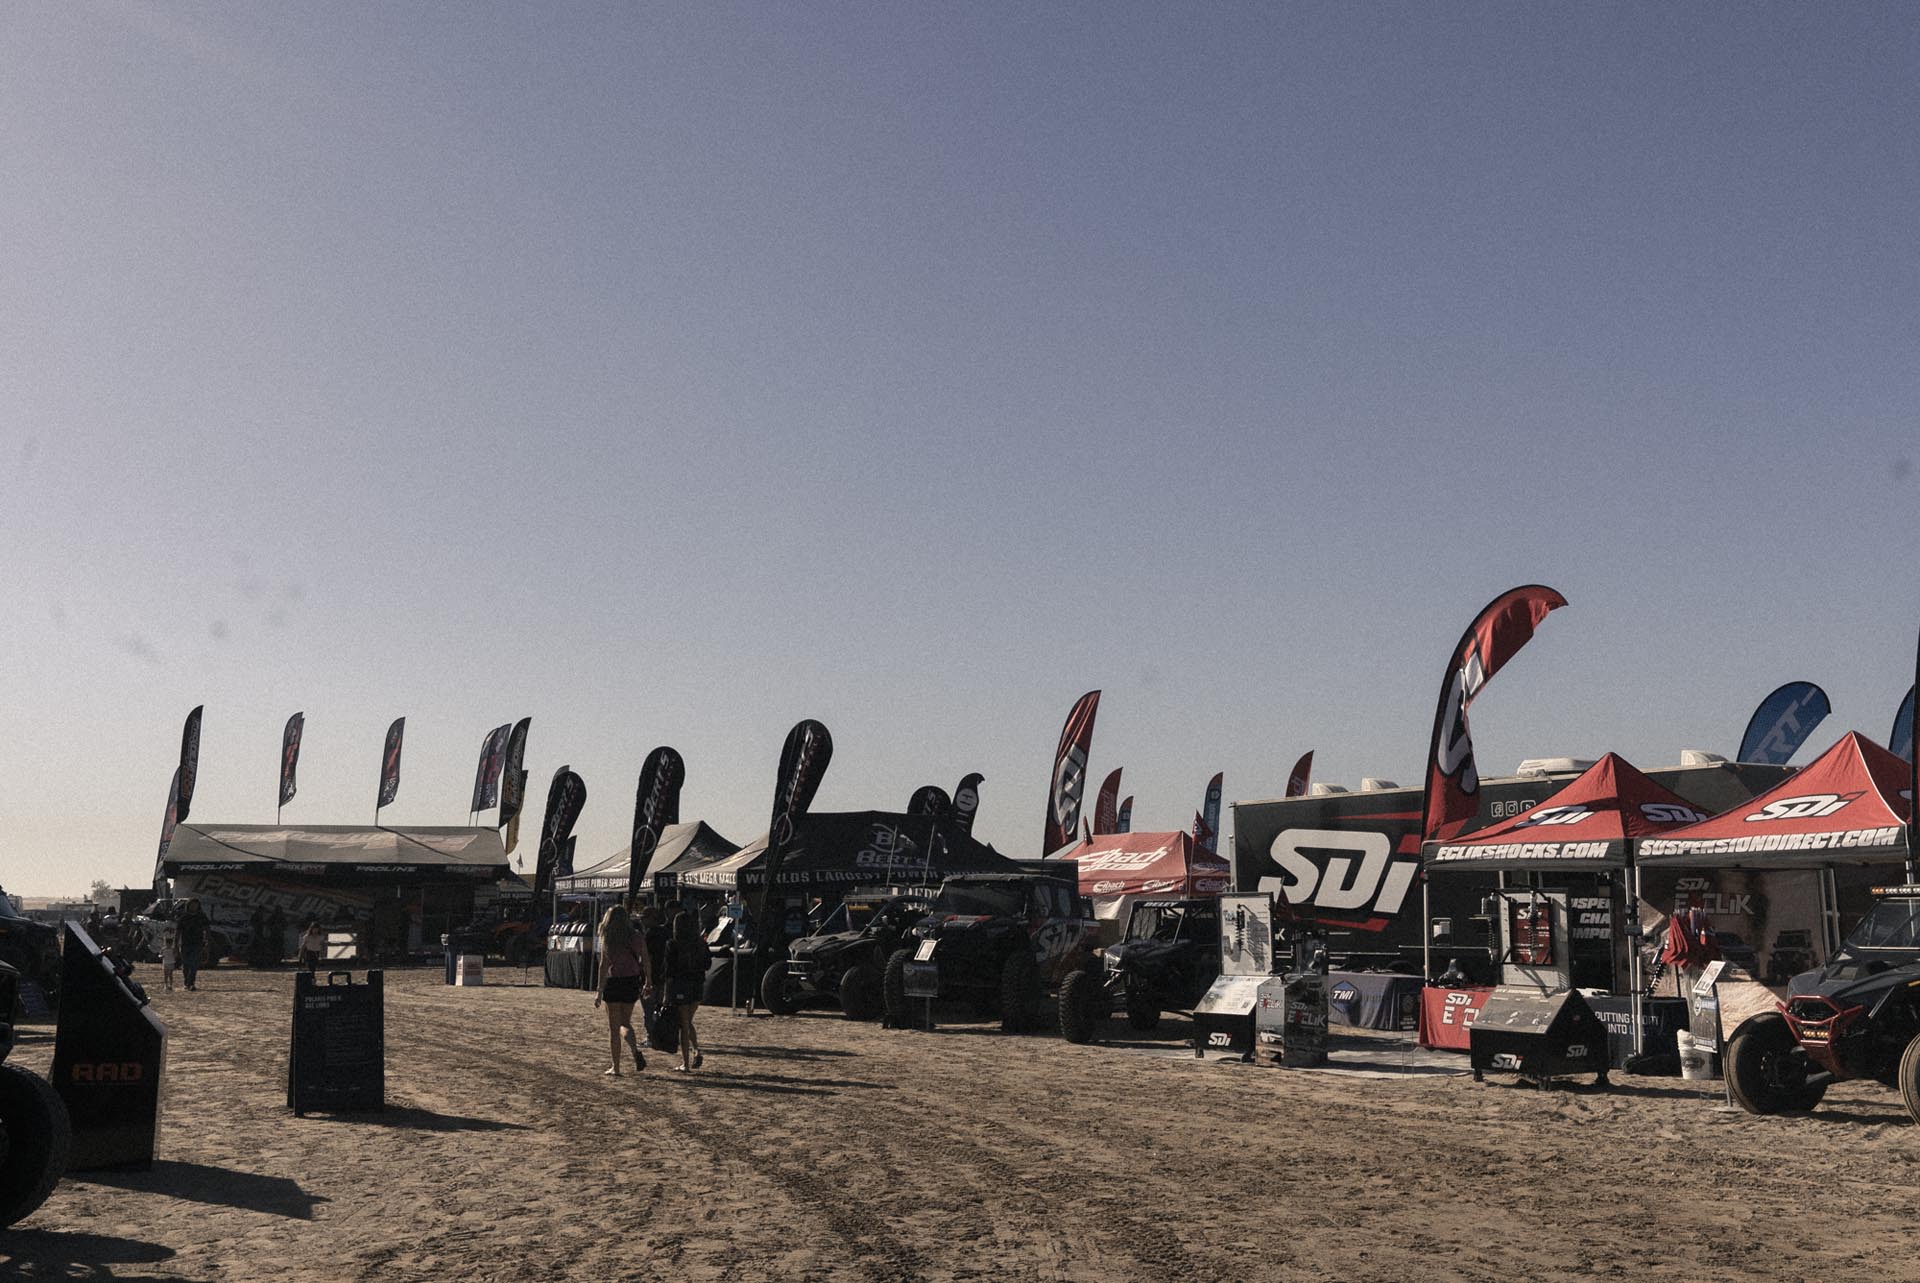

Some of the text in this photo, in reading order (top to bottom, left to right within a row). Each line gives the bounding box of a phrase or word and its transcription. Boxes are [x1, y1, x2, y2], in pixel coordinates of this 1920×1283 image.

[1639, 827, 1900, 856] SUSPENSIONDIRECT.COM
[1436, 843, 1610, 861] ECLIKSHOCKS.COM
[355, 865, 418, 873] PROLINE
[1333, 990, 1355, 1001] TMI
[1607, 1023, 1628, 1035] INTO
